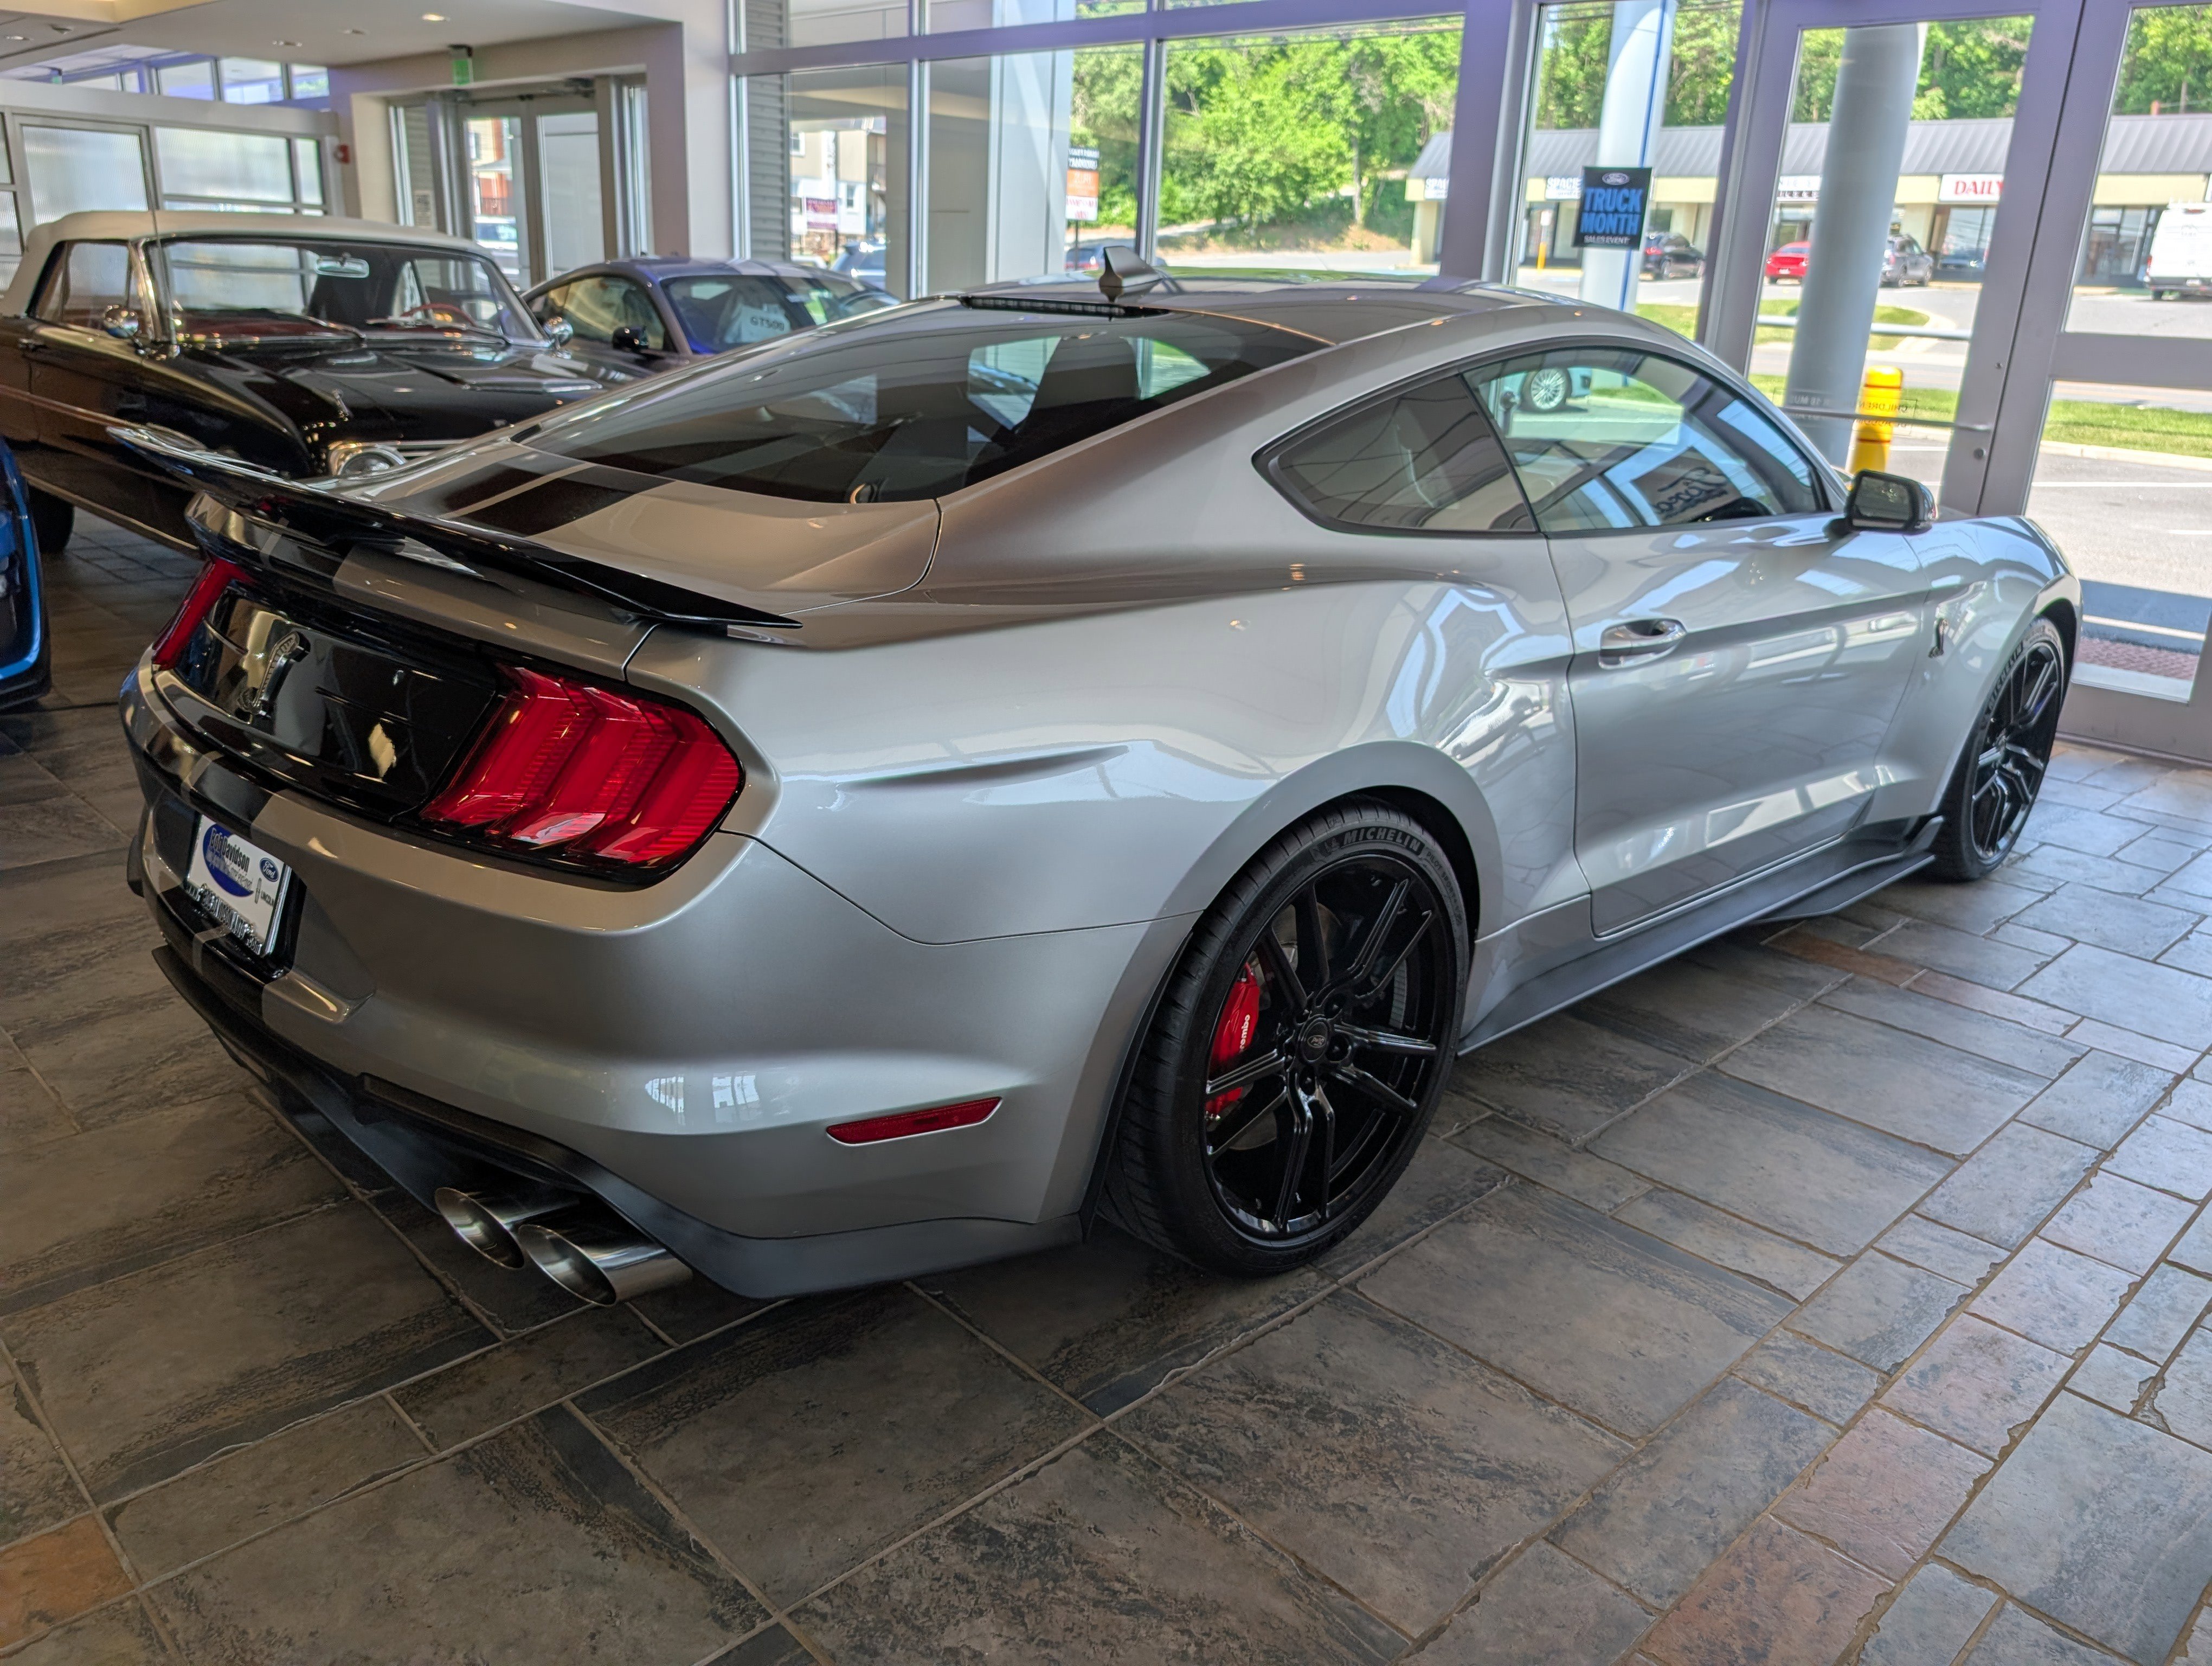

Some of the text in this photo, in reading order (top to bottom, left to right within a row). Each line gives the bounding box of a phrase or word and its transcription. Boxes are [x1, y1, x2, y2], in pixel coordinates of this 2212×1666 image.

[1584, 188, 1643, 212] TRUCK
[1580, 213, 1641, 235] MONTH
[750, 317, 785, 331] GT500
[209, 828, 223, 851] Bob
[222, 836, 250, 873] Davidson
[1343, 827, 1422, 852] MICHELIN
[1426, 850, 1442, 870] PILOT
[260, 890, 274, 908] LINCOLN
